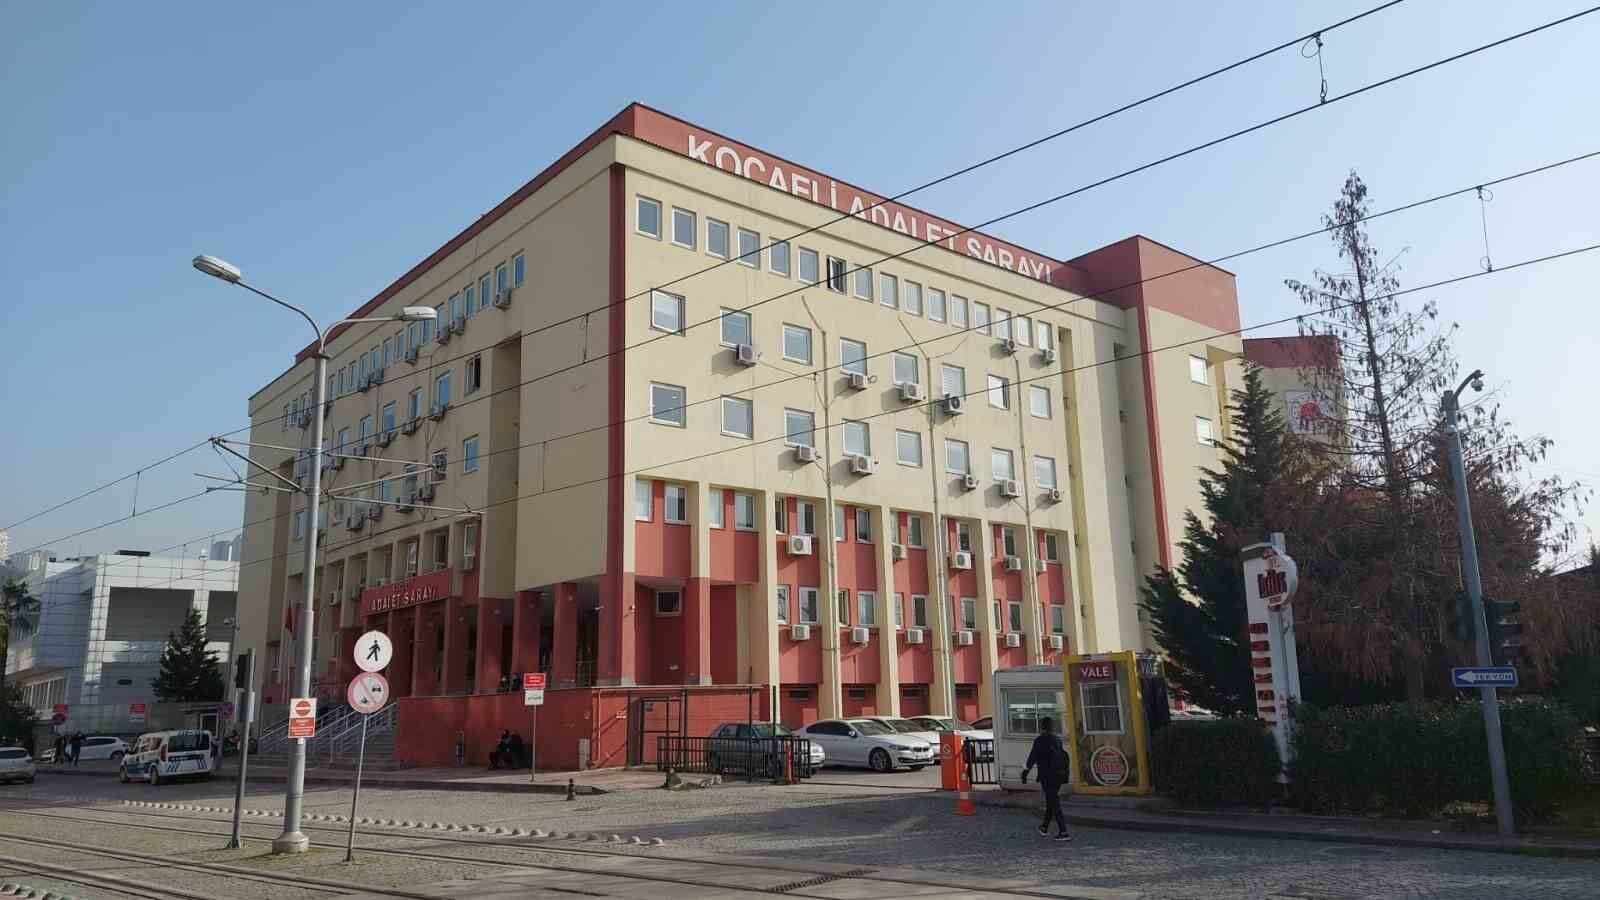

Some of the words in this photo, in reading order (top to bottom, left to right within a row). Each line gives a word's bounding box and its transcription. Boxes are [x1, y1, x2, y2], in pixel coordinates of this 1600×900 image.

[849, 196, 959, 250] ADALET
[965, 237, 1052, 283] SARAYI
[1081, 665, 1111, 678] VALE
